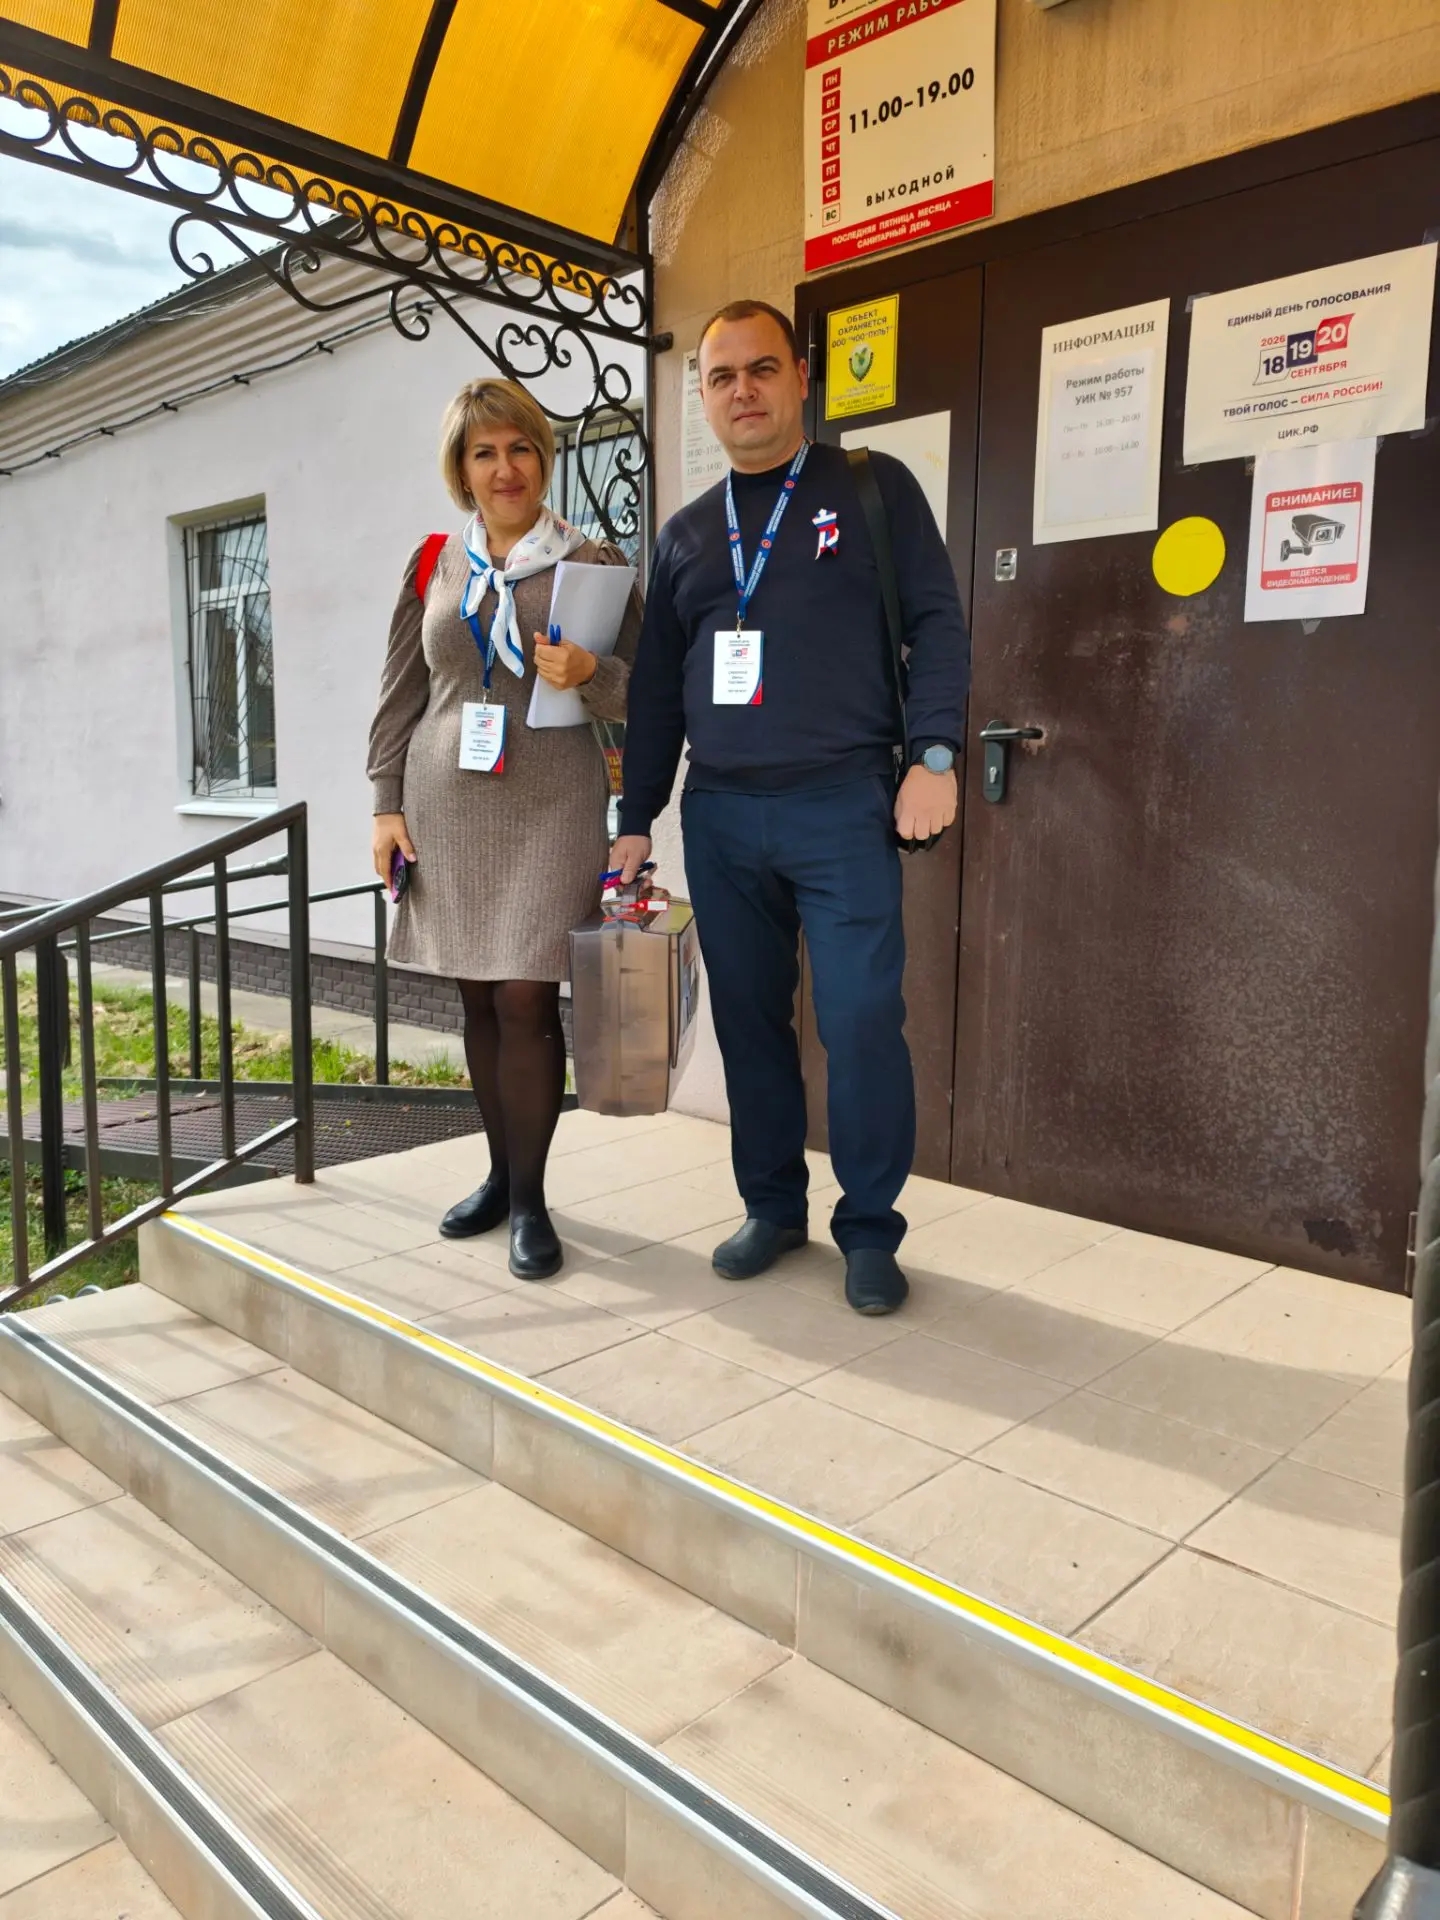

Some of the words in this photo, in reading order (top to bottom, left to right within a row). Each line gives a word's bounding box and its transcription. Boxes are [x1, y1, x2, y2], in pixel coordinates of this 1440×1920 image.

[828, 14, 889, 53] РЕЖИМ
[826, 74, 838, 87] ПН
[826, 97, 836, 108] ВТ
[825, 119, 837, 131] СР
[826, 142, 836, 153] ЧТ
[826, 164, 836, 176] ПТ
[826, 186, 837, 198] СБ
[826, 209, 837, 221] ВС
[866, 165, 955, 207] ВЫХОДНОЙ
[832, 224, 877, 246] ПОСЛЕДНЯЯ
[879, 212, 914, 230] ПЯТНИЦА
[918, 200, 951, 218] МЕСЯЦА
[857, 225, 907, 249] САНИТАРНЫЙ
[909, 219, 931, 234] ДЕНЬ
[1227, 307, 1272, 328] ЕДИНЫЙ
[1275, 303, 1303, 318] ДЕНЬ
[1306, 283, 1391, 310] ГОЛОСОВАНИЯ
[838, 316, 887, 336] ОХРАНЯЕТСЯ
[846, 309, 878, 324] ОБЪЕКТ
[1053, 320, 1155, 354] ИНФОРМАЦИЯ
[1261, 335, 1286, 347] 2026
[1262, 356, 1284, 376] 18
[1289, 340, 1312, 360] 19
[1318, 323, 1346, 345] 20
[1066, 374, 1102, 390] Режим
[1105, 366, 1144, 384] работы
[1290, 360, 1347, 379] СЕНТЯБРЯ
[1075, 391, 1097, 406] УИК
[1099, 389, 1112, 402] №
[1115, 386, 1133, 400] 957
[1223, 404, 1251, 418] ТВОЙ
[1252, 399, 1288, 413] ГОЛОС
[1300, 391, 1330, 405] СИЛА
[1333, 381, 1383, 399] РОССИИ!
[1278, 424, 1319, 440] ЦИК.РФ
[1272, 486, 1357, 508] ВНИМАНИЕ!
[1266, 573, 1351, 588] ВИДЕОНАБЛЮДЕНИЕ
[1290, 567, 1327, 578] ВЕДЕТСЯ
